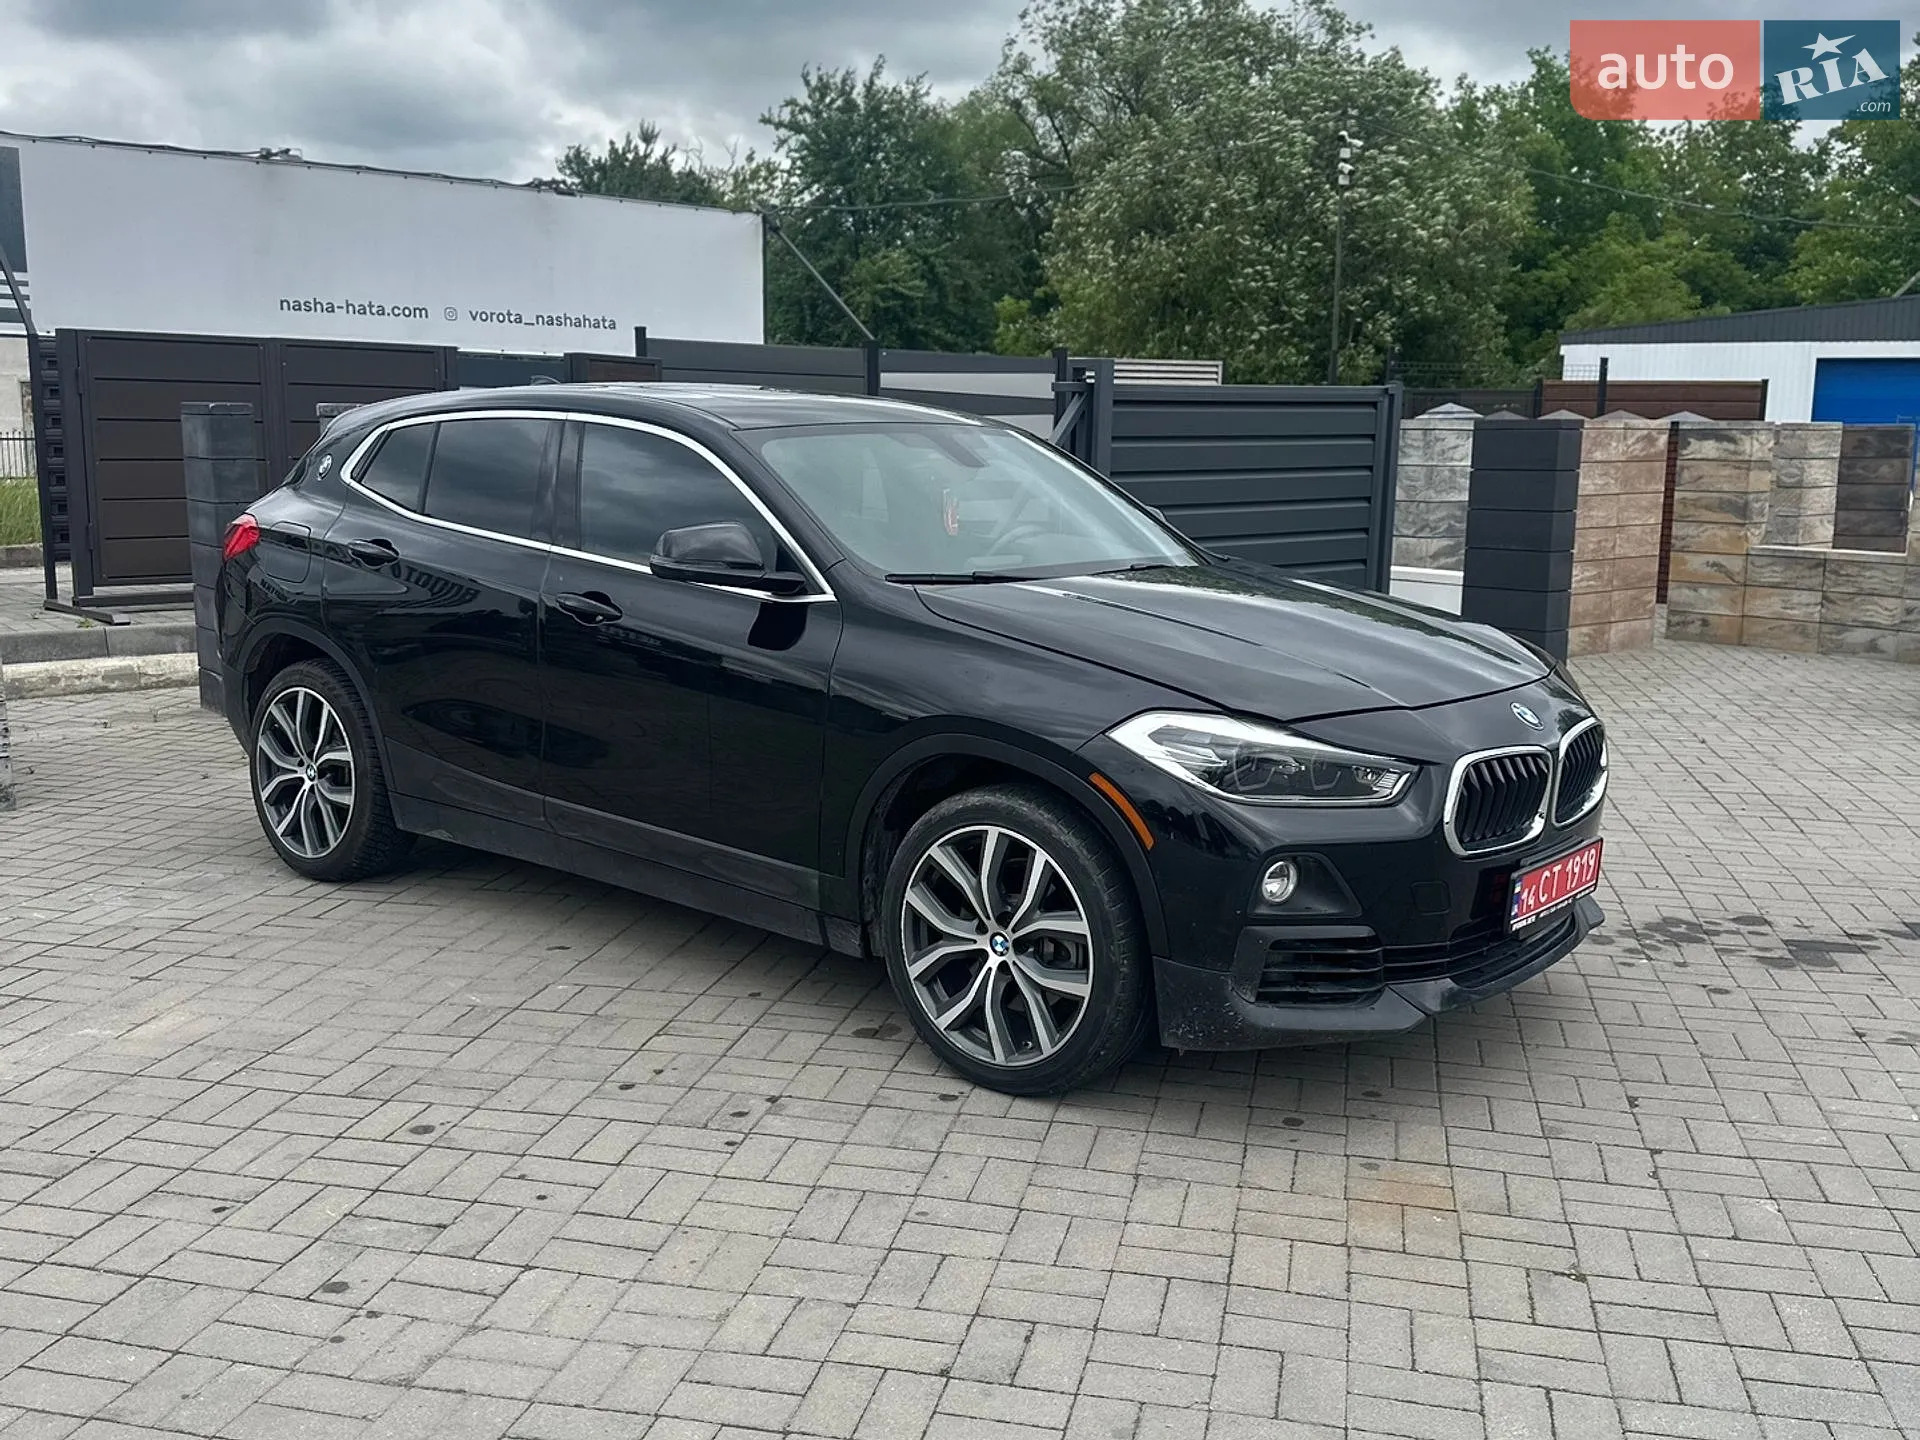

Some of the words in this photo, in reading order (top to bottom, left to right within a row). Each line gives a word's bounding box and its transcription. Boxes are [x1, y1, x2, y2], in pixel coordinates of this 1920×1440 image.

[279, 297, 429, 319] nasha-hata.com
[469, 309, 617, 330] vorota_nashahata
[1521, 884, 1537, 913] 14
[1538, 864, 1562, 904] CT
[1565, 848, 1597, 891] 1919
